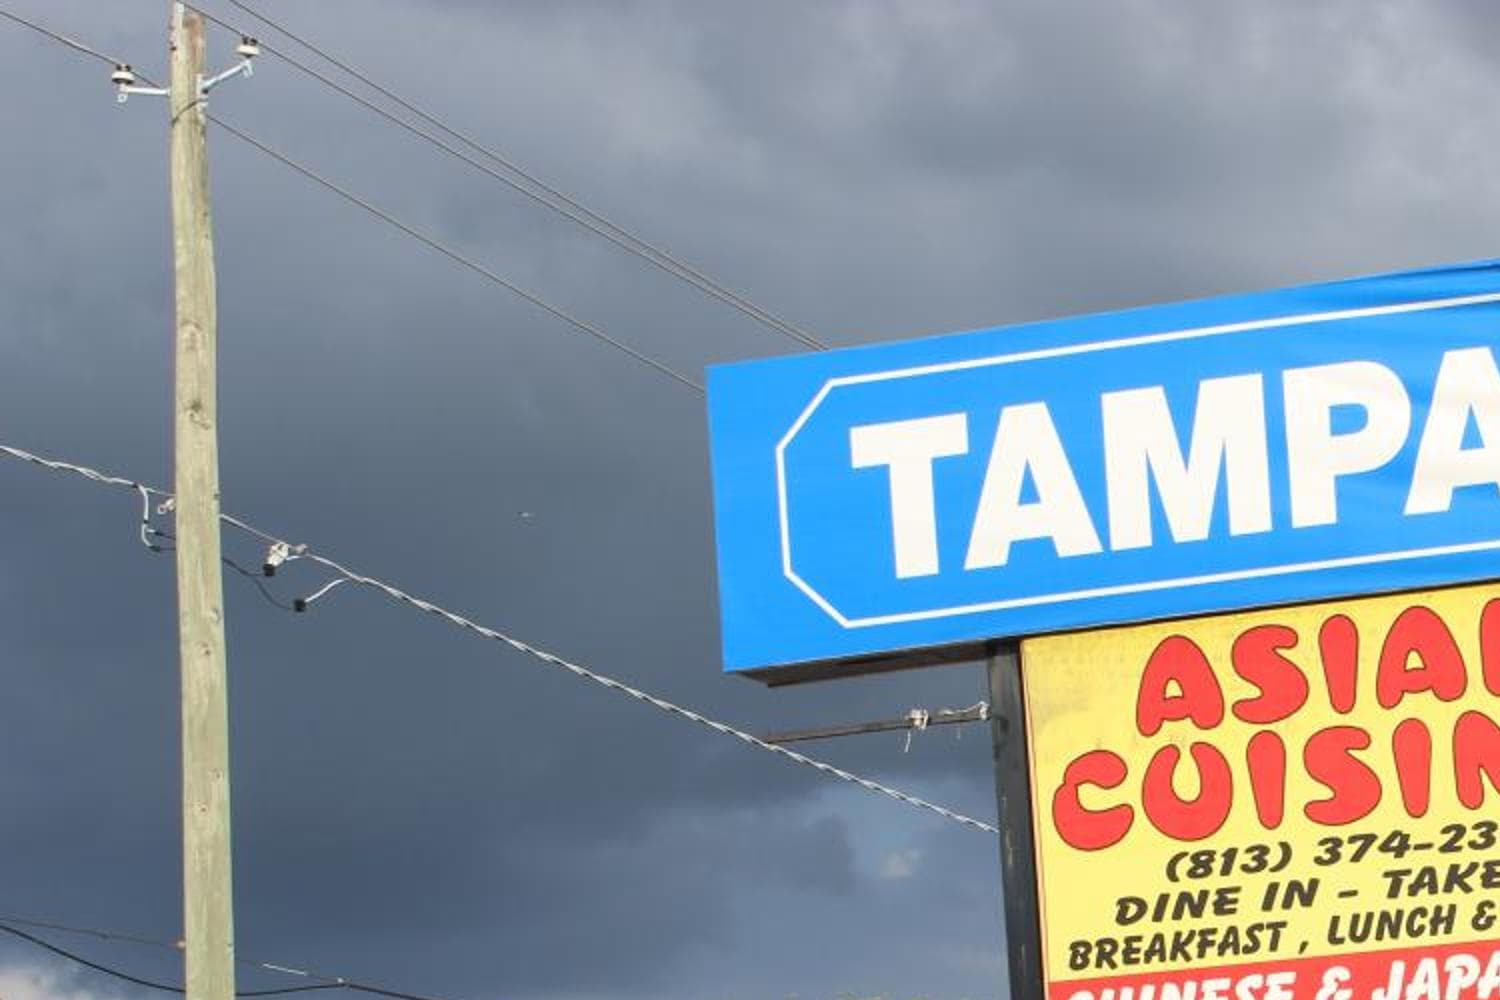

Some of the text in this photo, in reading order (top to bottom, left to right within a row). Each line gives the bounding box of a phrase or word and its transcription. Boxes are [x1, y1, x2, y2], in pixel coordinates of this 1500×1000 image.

[1165, 841, 1293, 882] (813)
[1115, 885, 1242, 926] DINE
[1261, 878, 1320, 912] IN
[1327, 903, 1457, 945] LUNCH
[1471, 900, 1497, 931] &
